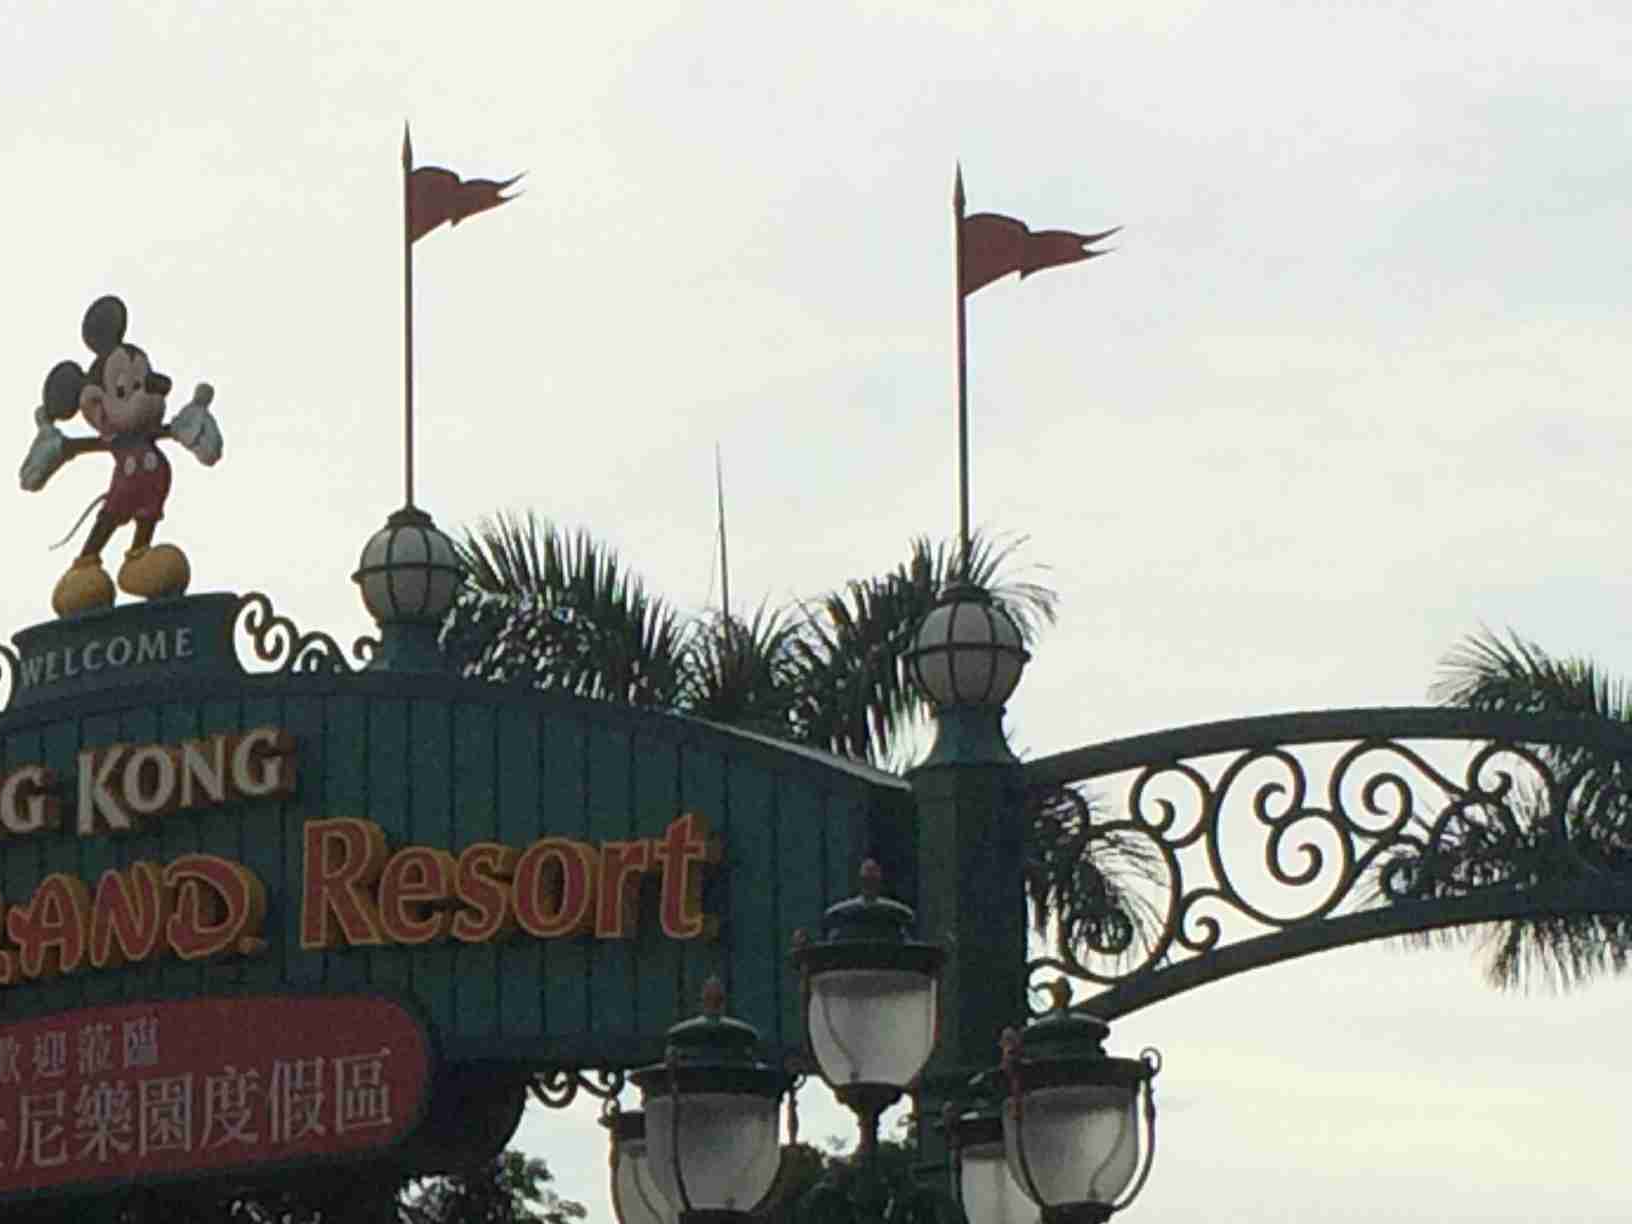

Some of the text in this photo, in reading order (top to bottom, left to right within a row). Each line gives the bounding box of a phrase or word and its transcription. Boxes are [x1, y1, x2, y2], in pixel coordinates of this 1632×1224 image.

[19, 625, 195, 690] WELCOME
[76, 727, 288, 838] KONG
[300, 811, 710, 951] Resort
